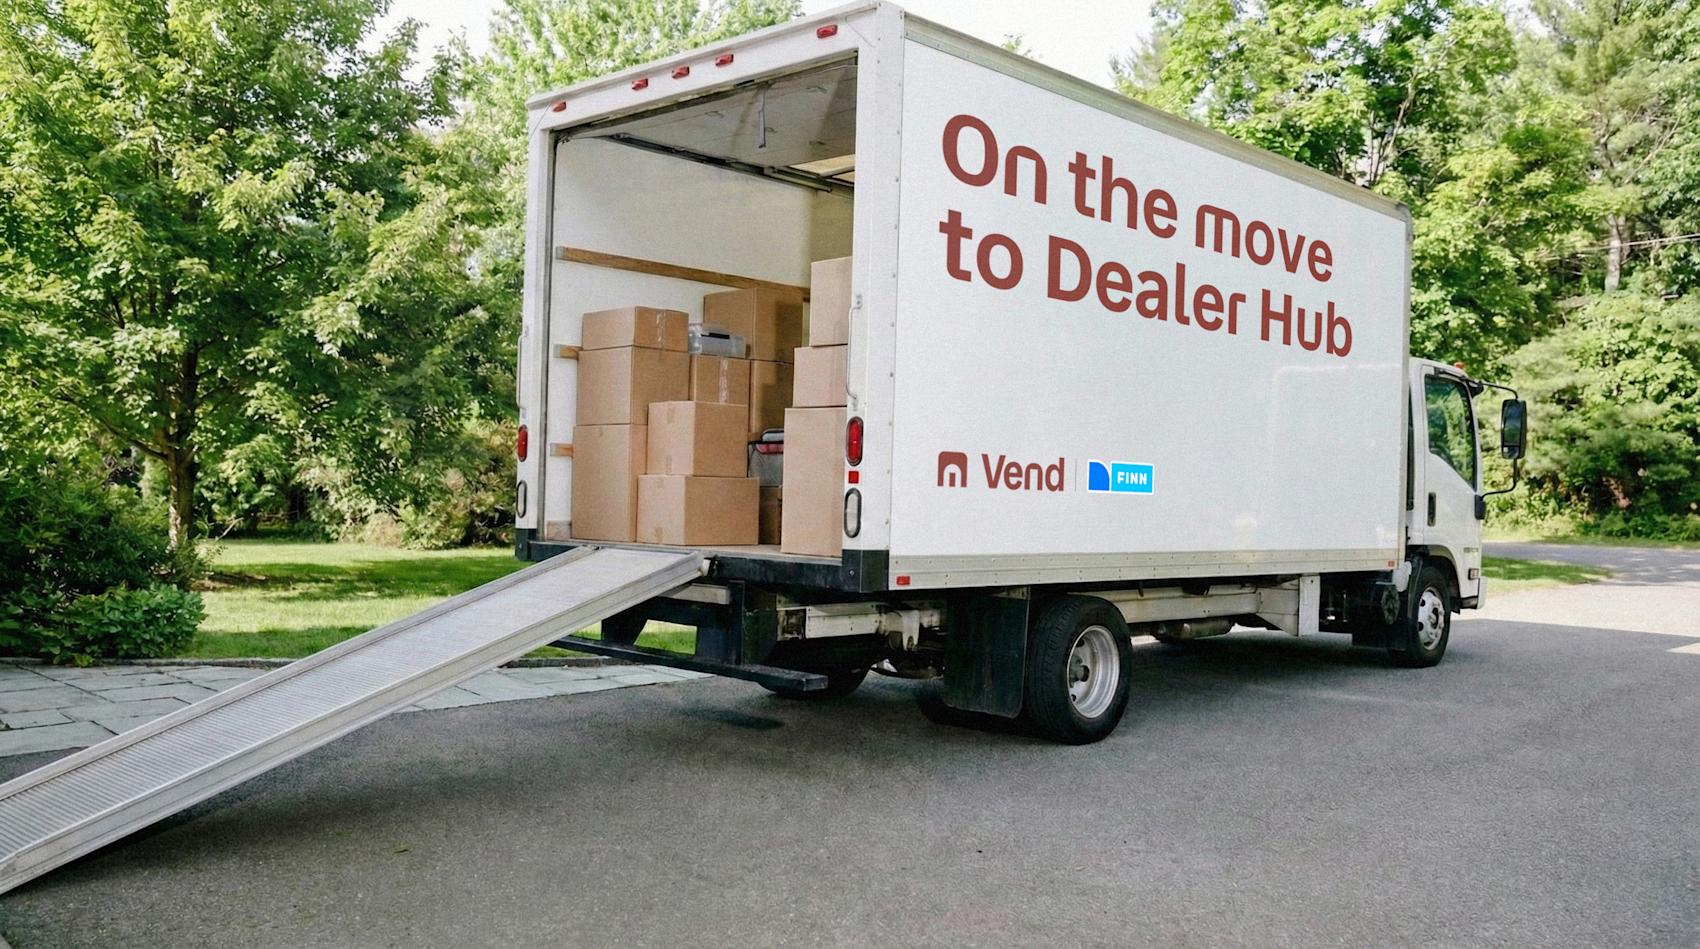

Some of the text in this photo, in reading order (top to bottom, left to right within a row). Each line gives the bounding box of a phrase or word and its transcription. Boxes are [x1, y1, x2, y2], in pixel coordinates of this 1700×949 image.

[942, 114, 1333, 283] On the move
[939, 209, 1353, 358] to Dealer Hub
[981, 453, 1065, 492] Vend
[1116, 471, 1147, 485] FINN
